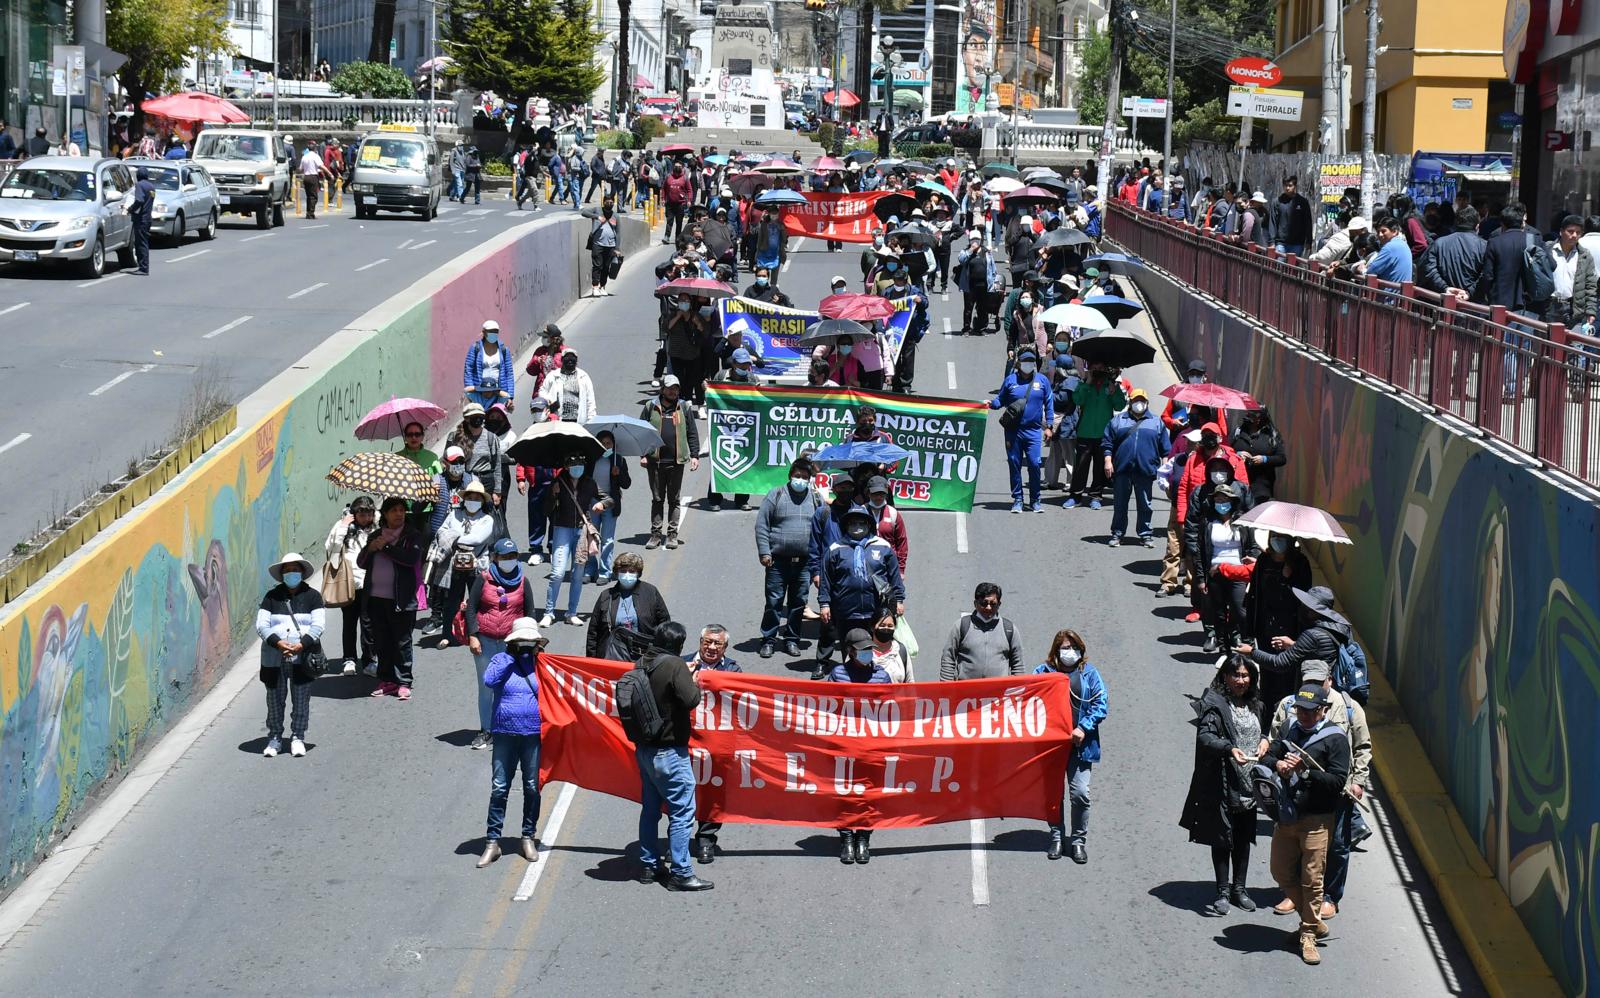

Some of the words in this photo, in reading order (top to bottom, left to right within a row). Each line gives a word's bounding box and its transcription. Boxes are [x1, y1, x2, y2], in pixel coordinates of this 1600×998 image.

[1231, 66, 1274, 80] MONOPOL
[1255, 104, 1298, 115] ITURRALDE
[1320, 164, 1362, 176] PROGRAM
[816, 221, 837, 235] EL
[317, 382, 362, 434] CAMACHO
[713, 413, 755, 426] INCOS
[769, 403, 856, 425] CÉLULA
[873, 412, 970, 437] INDICAL
[765, 424, 833, 439] INSTITUTO
[897, 433, 975, 453] COMERCIAL
[902, 449, 978, 482] ALTO
[773, 693, 901, 738] URBANO
[912, 686, 1047, 739] PACEÑO
[733, 749, 767, 789] T.
[784, 752, 817, 794] E.
[833, 756, 866, 795] U.
[882, 755, 917, 794] L.
[930, 756, 961, 793] P.
